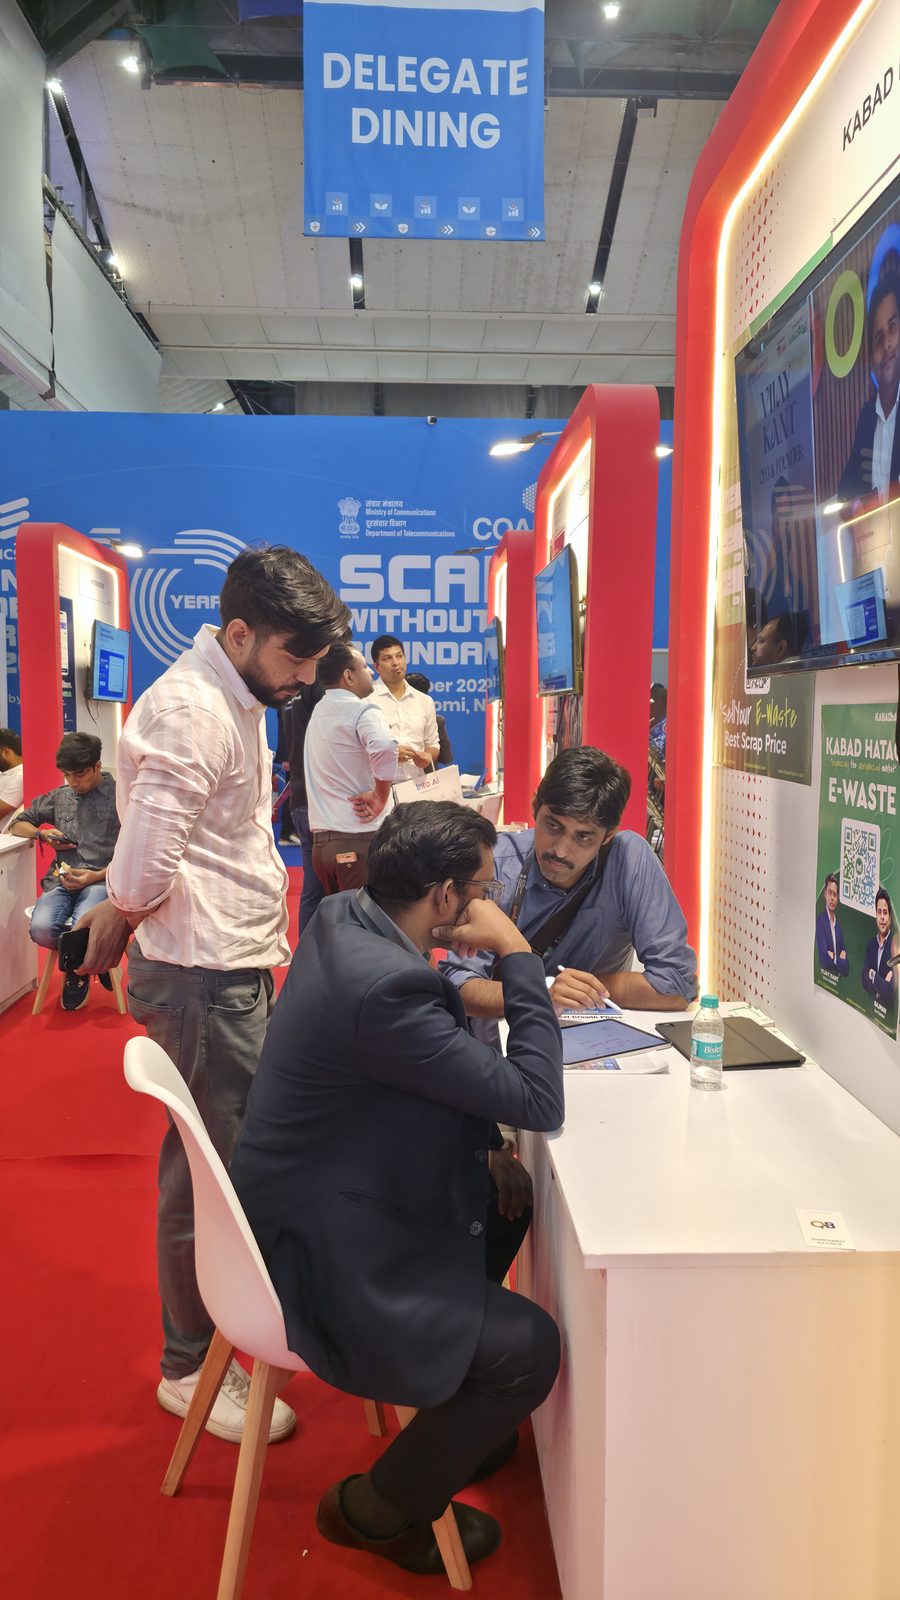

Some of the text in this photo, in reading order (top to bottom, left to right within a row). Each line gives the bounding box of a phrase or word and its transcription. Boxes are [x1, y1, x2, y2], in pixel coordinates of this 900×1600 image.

[323, 52, 529, 96] DELEGATE
[843, 66, 894, 152] KABAD
[351, 107, 501, 149] DINING
[366, 508, 386, 516] Ministry
[366, 530, 396, 538] Department
[403, 530, 455, 538] Telecommunications
[473, 518, 531, 540] COA
[170, 595, 221, 609] YEAR
[350, 609, 488, 633] WITHOUT
[456, 679, 487, 692] 202
[756, 698, 797, 728] E-Waste
[725, 731, 787, 755] Best Scrap Price
[826, 737, 862, 757] KABAD
[415, 780, 431, 791] Into
[828, 777, 896, 815] E-WASTE
